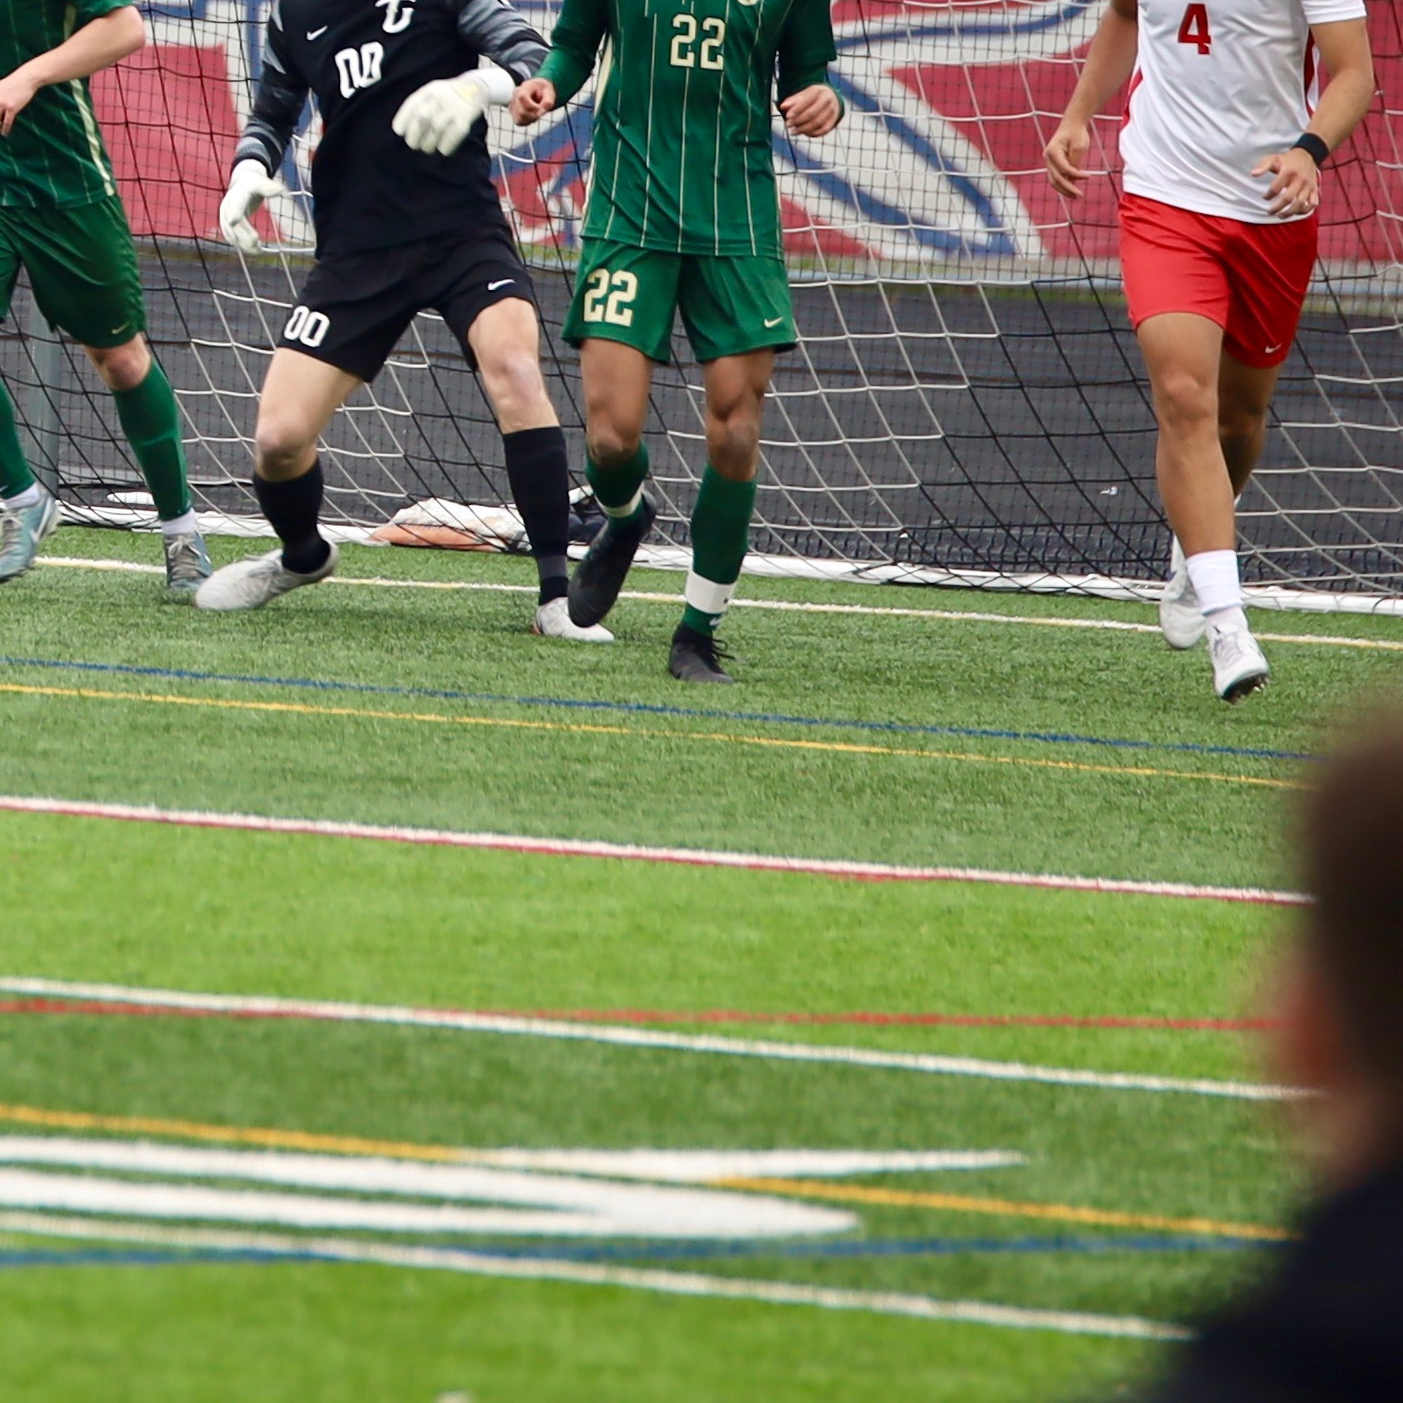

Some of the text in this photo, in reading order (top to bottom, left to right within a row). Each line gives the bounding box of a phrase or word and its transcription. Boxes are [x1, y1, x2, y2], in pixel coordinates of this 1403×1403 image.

[669, 13, 726, 71] 22
[1177, 2, 1212, 56] 4
[583, 268, 638, 327] 22
[284, 305, 332, 348] 00
